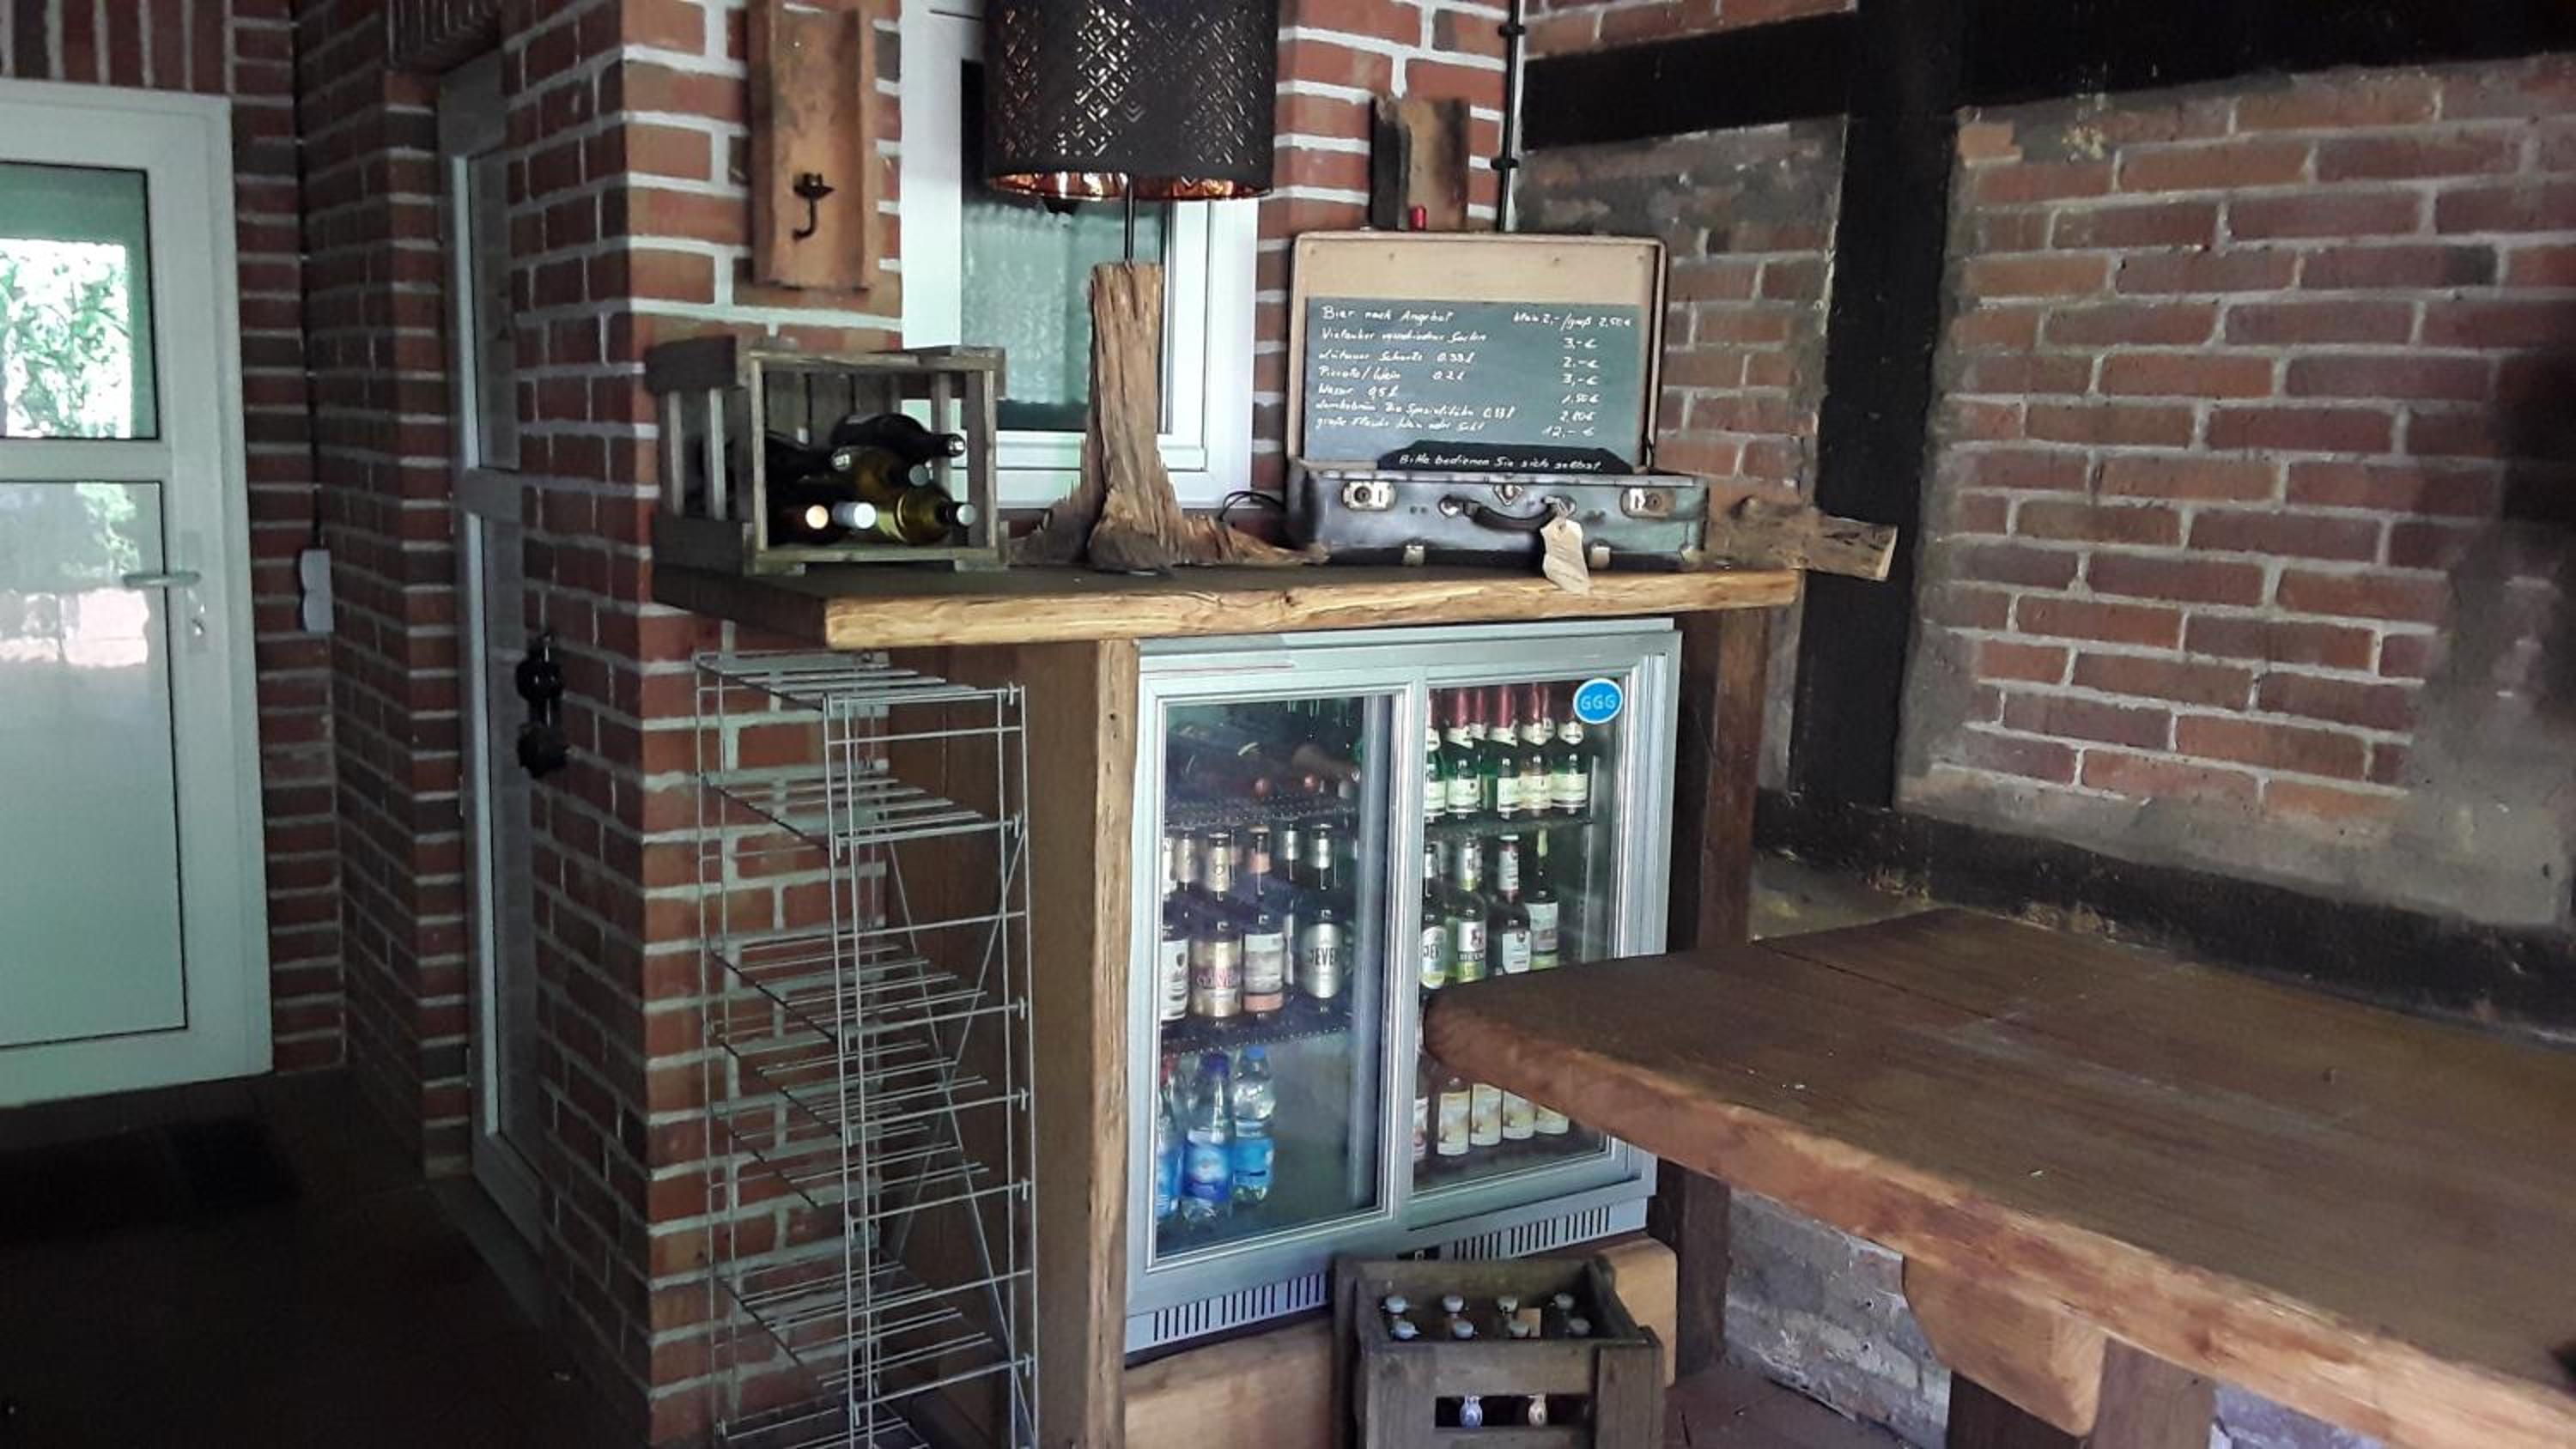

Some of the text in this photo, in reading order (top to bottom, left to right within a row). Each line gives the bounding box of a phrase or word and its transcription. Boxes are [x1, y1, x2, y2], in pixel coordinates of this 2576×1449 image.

[1321, 306, 1355, 320] Bier
[1365, 309, 1391, 321] nach
[1400, 309, 1454, 326] Angebot
[1399, 452, 1430, 464] Bitte
[1435, 453, 1490, 467] bedienen
[1494, 455, 1514, 468] Sie
[1521, 458, 1550, 469] sich
[1581, 694, 1617, 711] GGG
